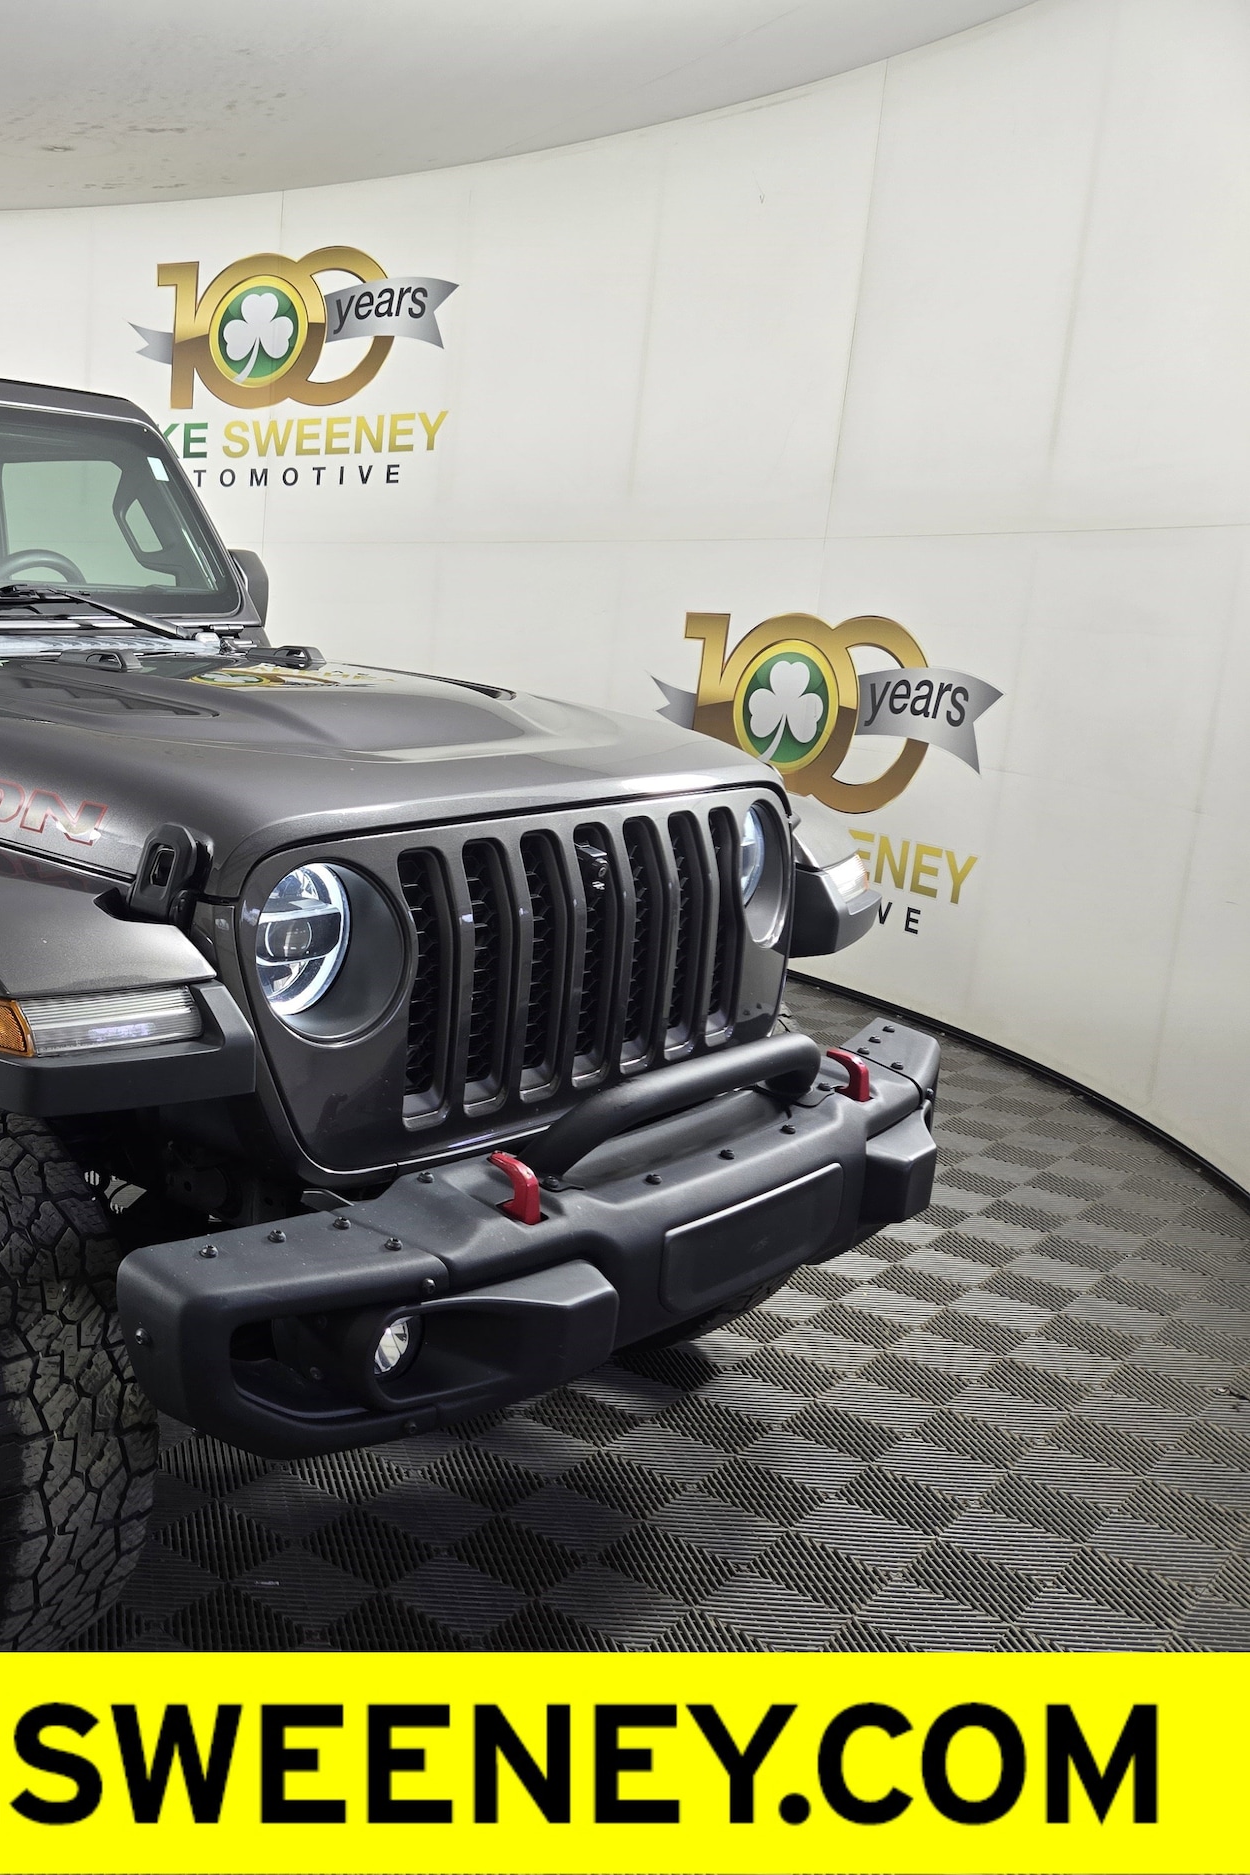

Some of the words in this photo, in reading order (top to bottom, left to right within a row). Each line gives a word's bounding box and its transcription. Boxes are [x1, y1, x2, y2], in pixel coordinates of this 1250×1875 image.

[333, 284, 429, 335] years
[222, 411, 449, 459] SWEENEY
[193, 464, 401, 488] TOMOTIVE
[863, 678, 970, 728] years
